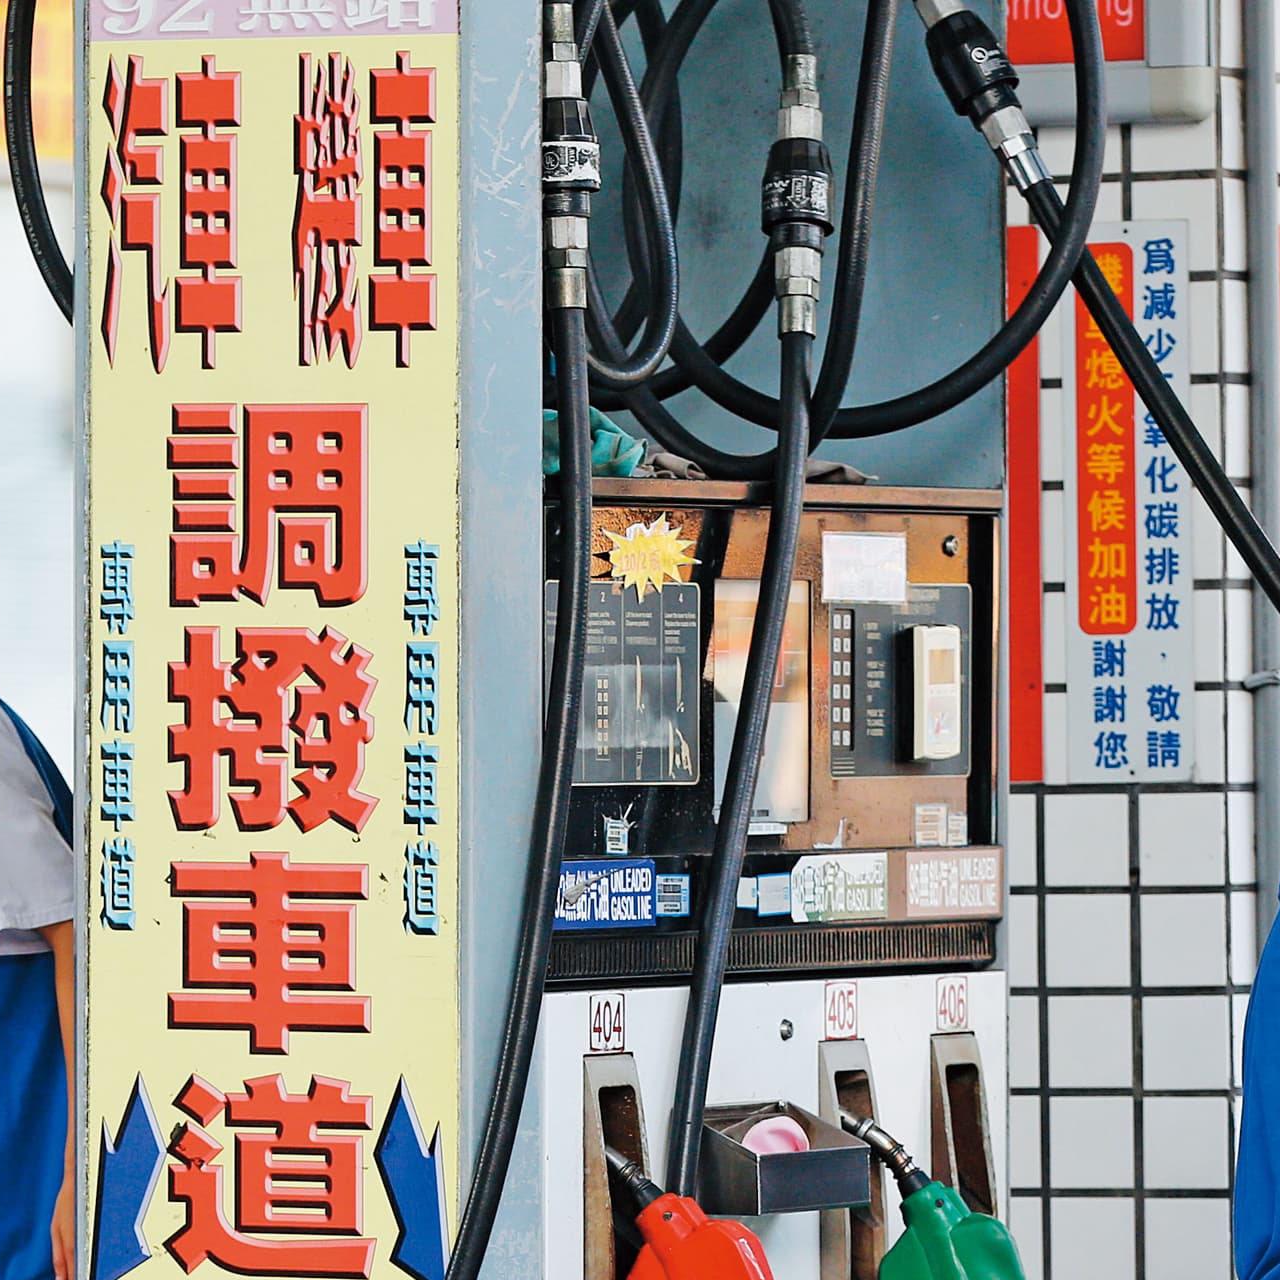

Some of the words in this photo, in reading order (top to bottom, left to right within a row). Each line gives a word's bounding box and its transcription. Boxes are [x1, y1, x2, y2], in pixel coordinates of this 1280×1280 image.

[1092, 640, 1128, 769] 謝謝您
[610, 866, 652, 893] UNLEADED
[610, 894, 652, 921] GASOLINE
[593, 1000, 623, 1043] 404
[828, 989, 856, 1031] 405
[938, 982, 966, 1024] 406
